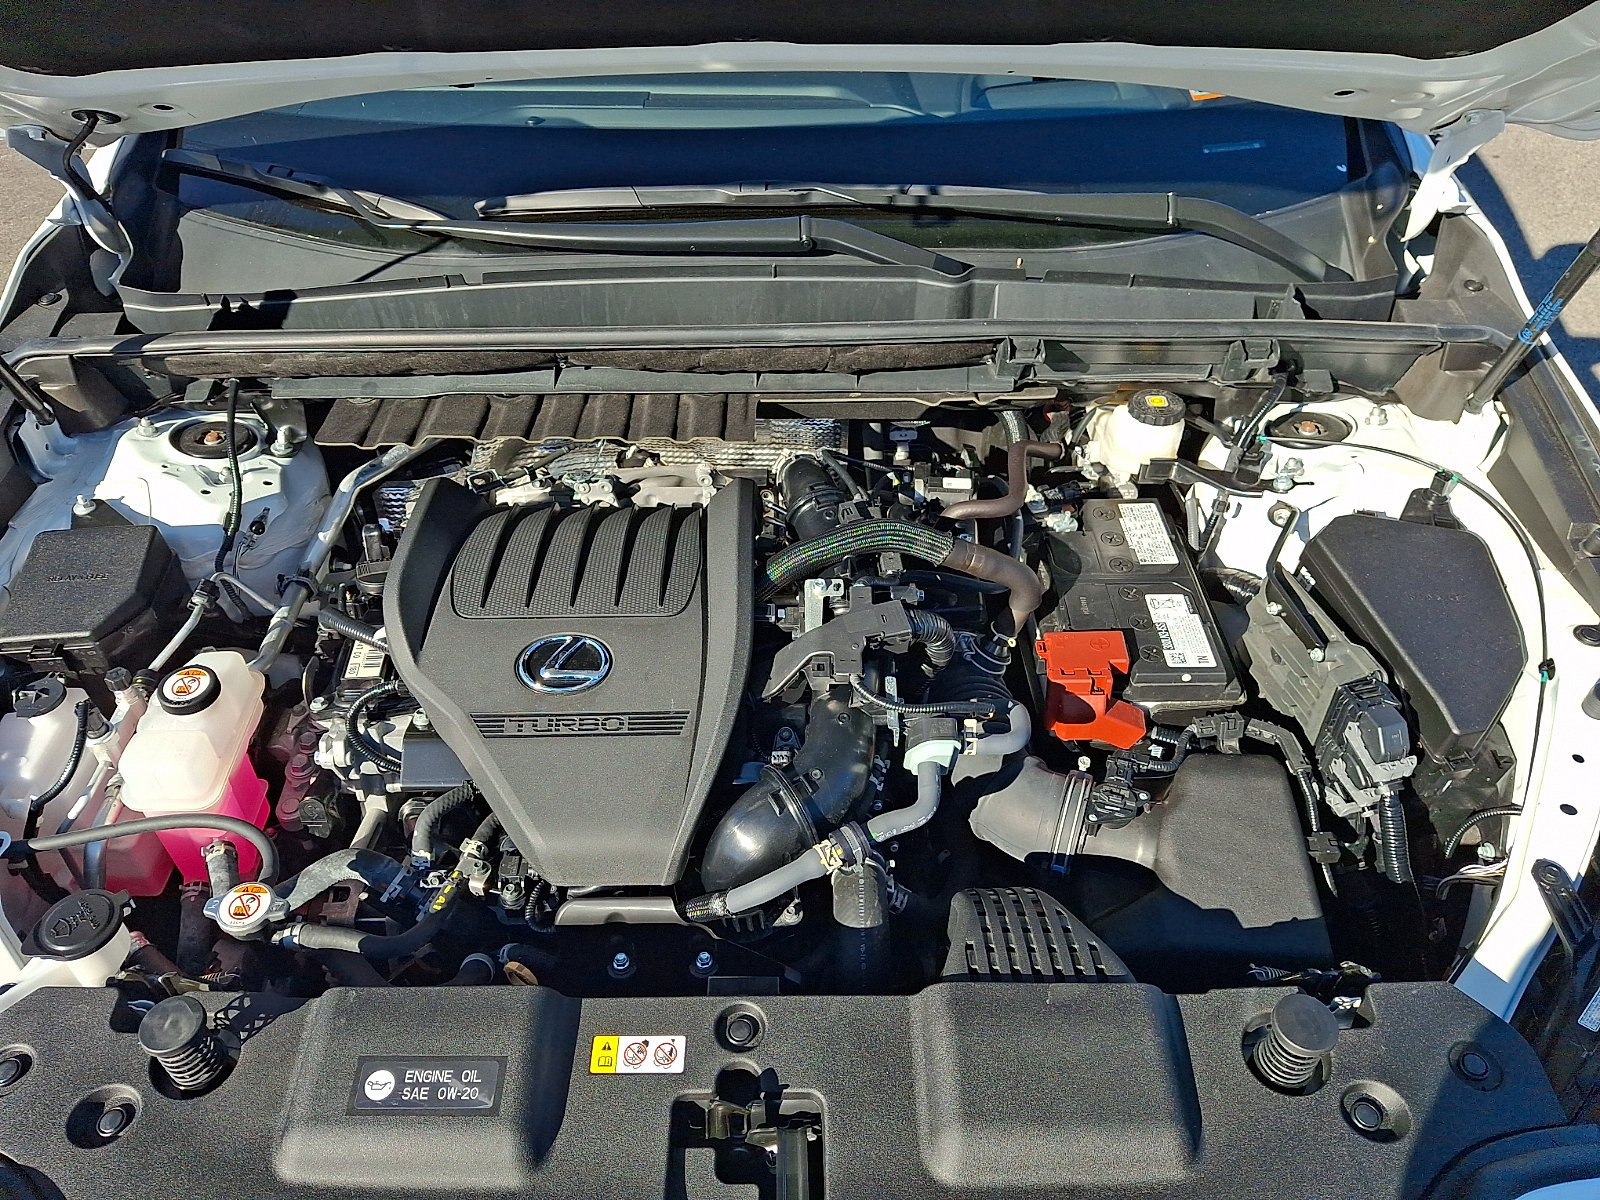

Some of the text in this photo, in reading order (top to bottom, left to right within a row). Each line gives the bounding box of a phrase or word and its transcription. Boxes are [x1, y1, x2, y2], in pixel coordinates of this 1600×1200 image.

[508, 716, 626, 733] TURBO
[404, 1069, 482, 1083] ENGINE OIL
[401, 1087, 479, 1100] SAE 0W-20
